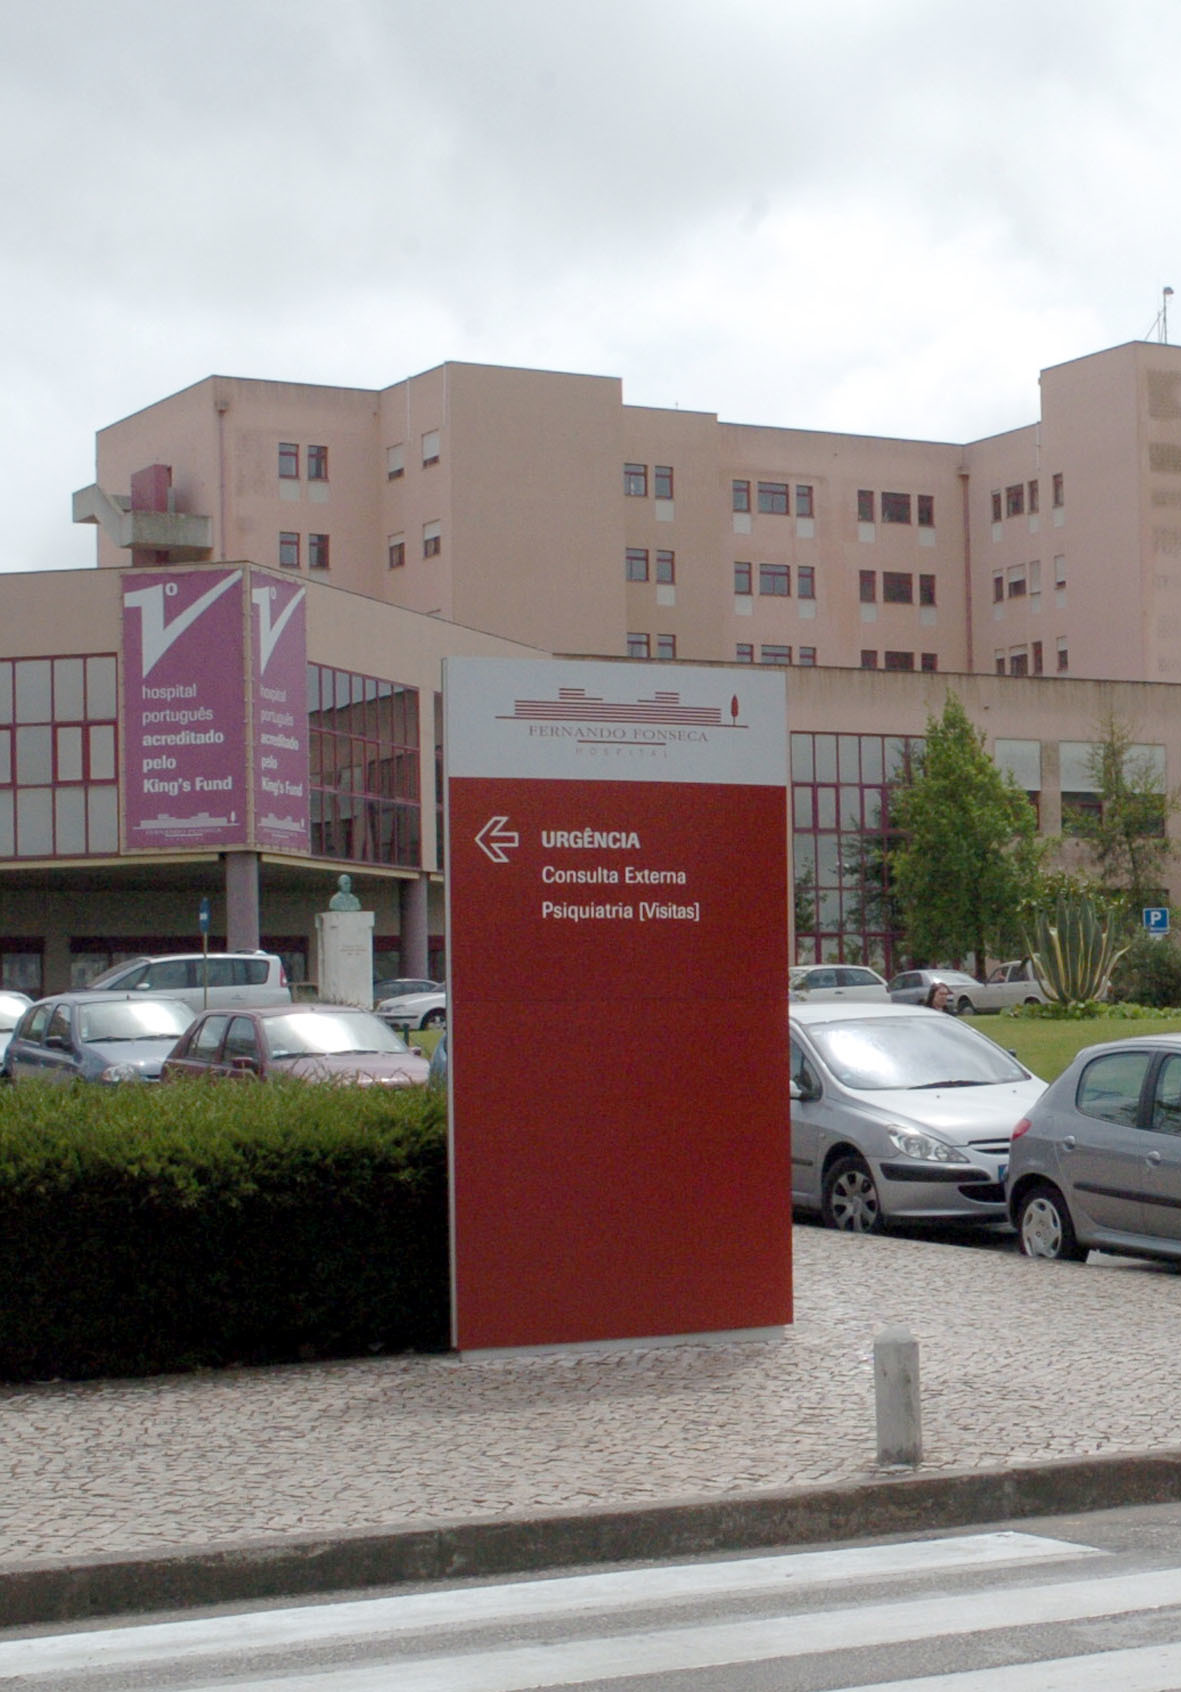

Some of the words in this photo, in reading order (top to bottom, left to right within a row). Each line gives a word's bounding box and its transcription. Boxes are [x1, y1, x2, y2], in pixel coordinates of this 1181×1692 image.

[142, 683, 197, 701] hospital
[142, 707, 214, 726] português
[143, 730, 224, 746] acreditado
[528, 725, 626, 740] FERNANDO
[633, 728, 709, 743] FONSECA
[143, 755, 176, 773] pelo
[143, 778, 192, 796] King's
[195, 776, 233, 791] Fund
[541, 827, 641, 849] URGÊNCIA
[542, 866, 619, 884] Consulta
[624, 867, 687, 885] Externa
[542, 901, 633, 923] Psiquiatria
[639, 902, 700, 922] [Visitas]
[1150, 911, 1162, 926] P
